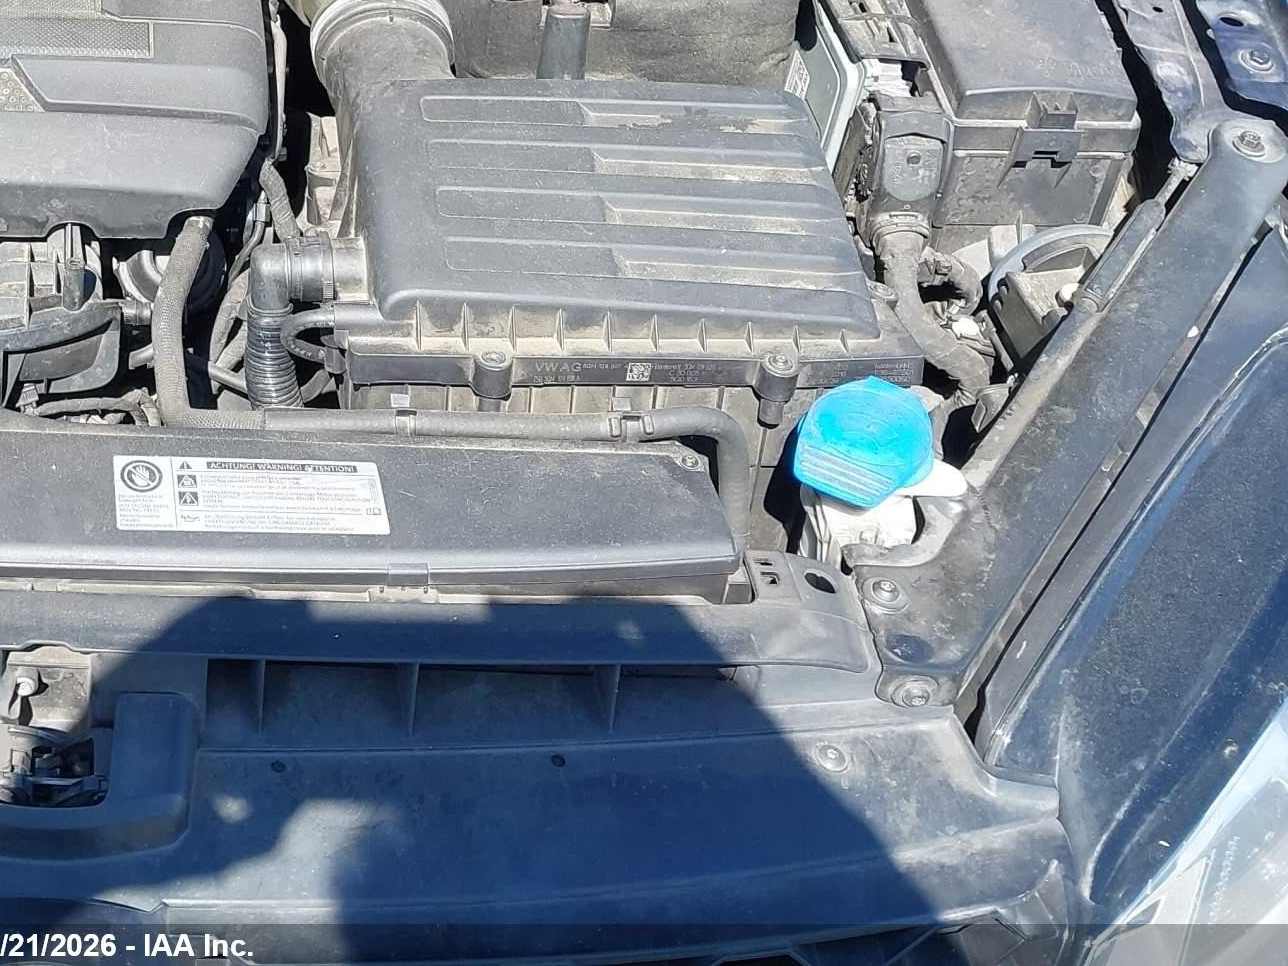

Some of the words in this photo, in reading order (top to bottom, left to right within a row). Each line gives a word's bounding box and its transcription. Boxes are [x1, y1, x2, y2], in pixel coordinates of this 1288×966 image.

[210, 462, 255, 470] ACHTUNG!
[257, 463, 303, 471] WARNING!
[304, 464, 354, 473] ATTENTION!
